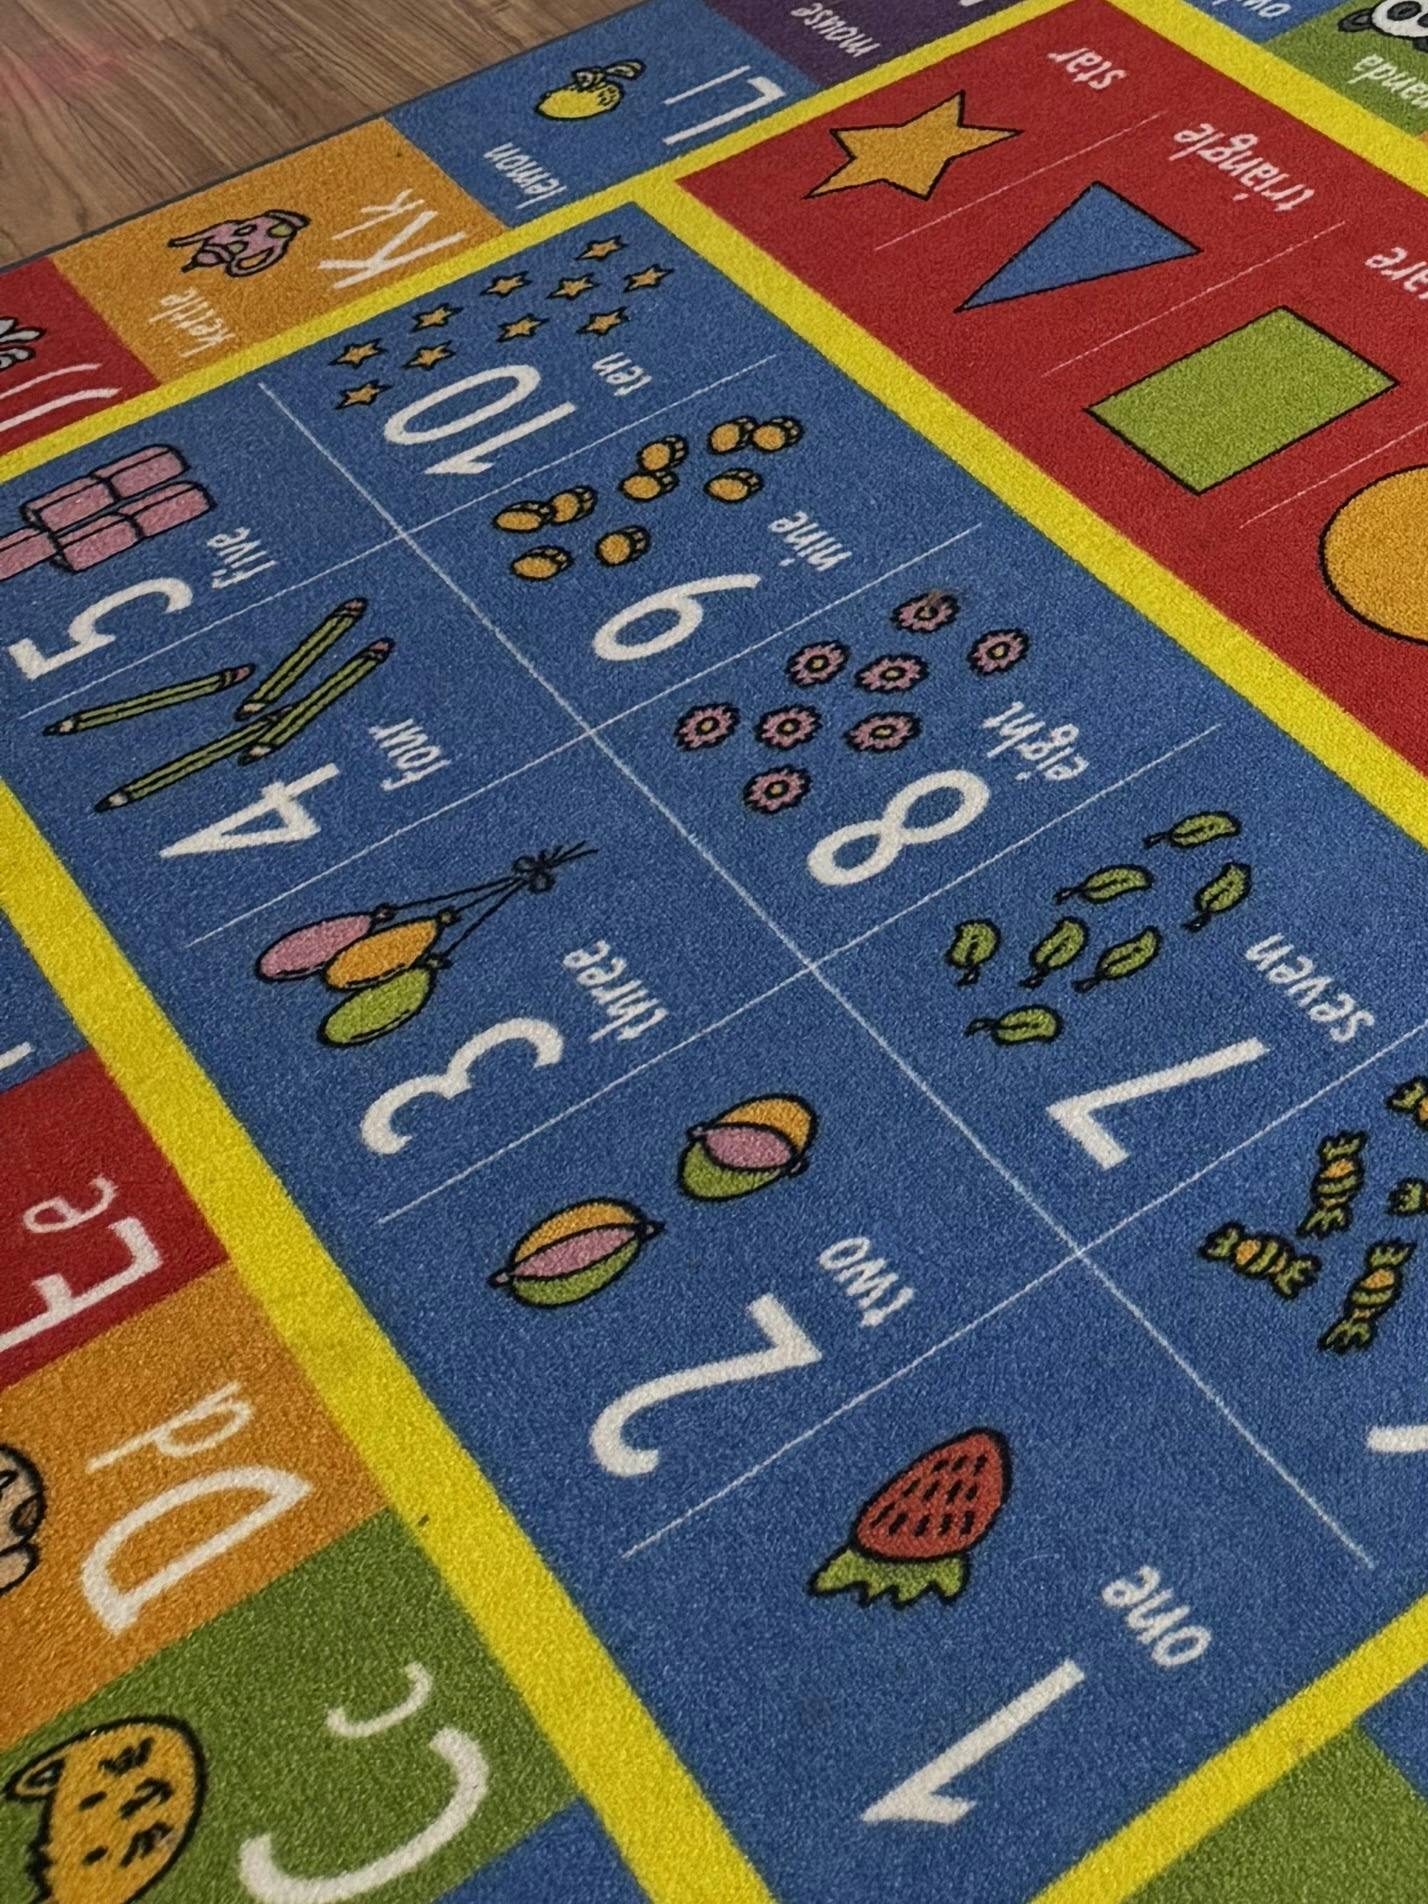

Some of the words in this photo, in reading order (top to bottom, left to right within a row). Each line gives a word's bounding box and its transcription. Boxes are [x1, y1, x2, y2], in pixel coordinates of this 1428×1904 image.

[1047, 47, 1126, 90] star
[1169, 123, 1315, 212] triangle
[383, 364, 576, 475] 10
[592, 352, 652, 397] ten
[206, 526, 277, 589] five
[768, 510, 852, 572] nine
[7, 577, 193, 681] 5
[591, 573, 762, 663] 9
[368, 718, 451, 791] four
[159, 763, 340, 858] 4
[807, 769, 991, 890] 8
[562, 940, 668, 1042] three
[1244, 932, 1375, 1043] seven
[359, 1017, 564, 1156] 3
[1045, 1036, 1270, 1171] 7
[818, 1236, 914, 1327] two
[589, 1293, 823, 1478] 2
[1102, 1565, 1212, 1668] one
[860, 1658, 1086, 1825] 1
